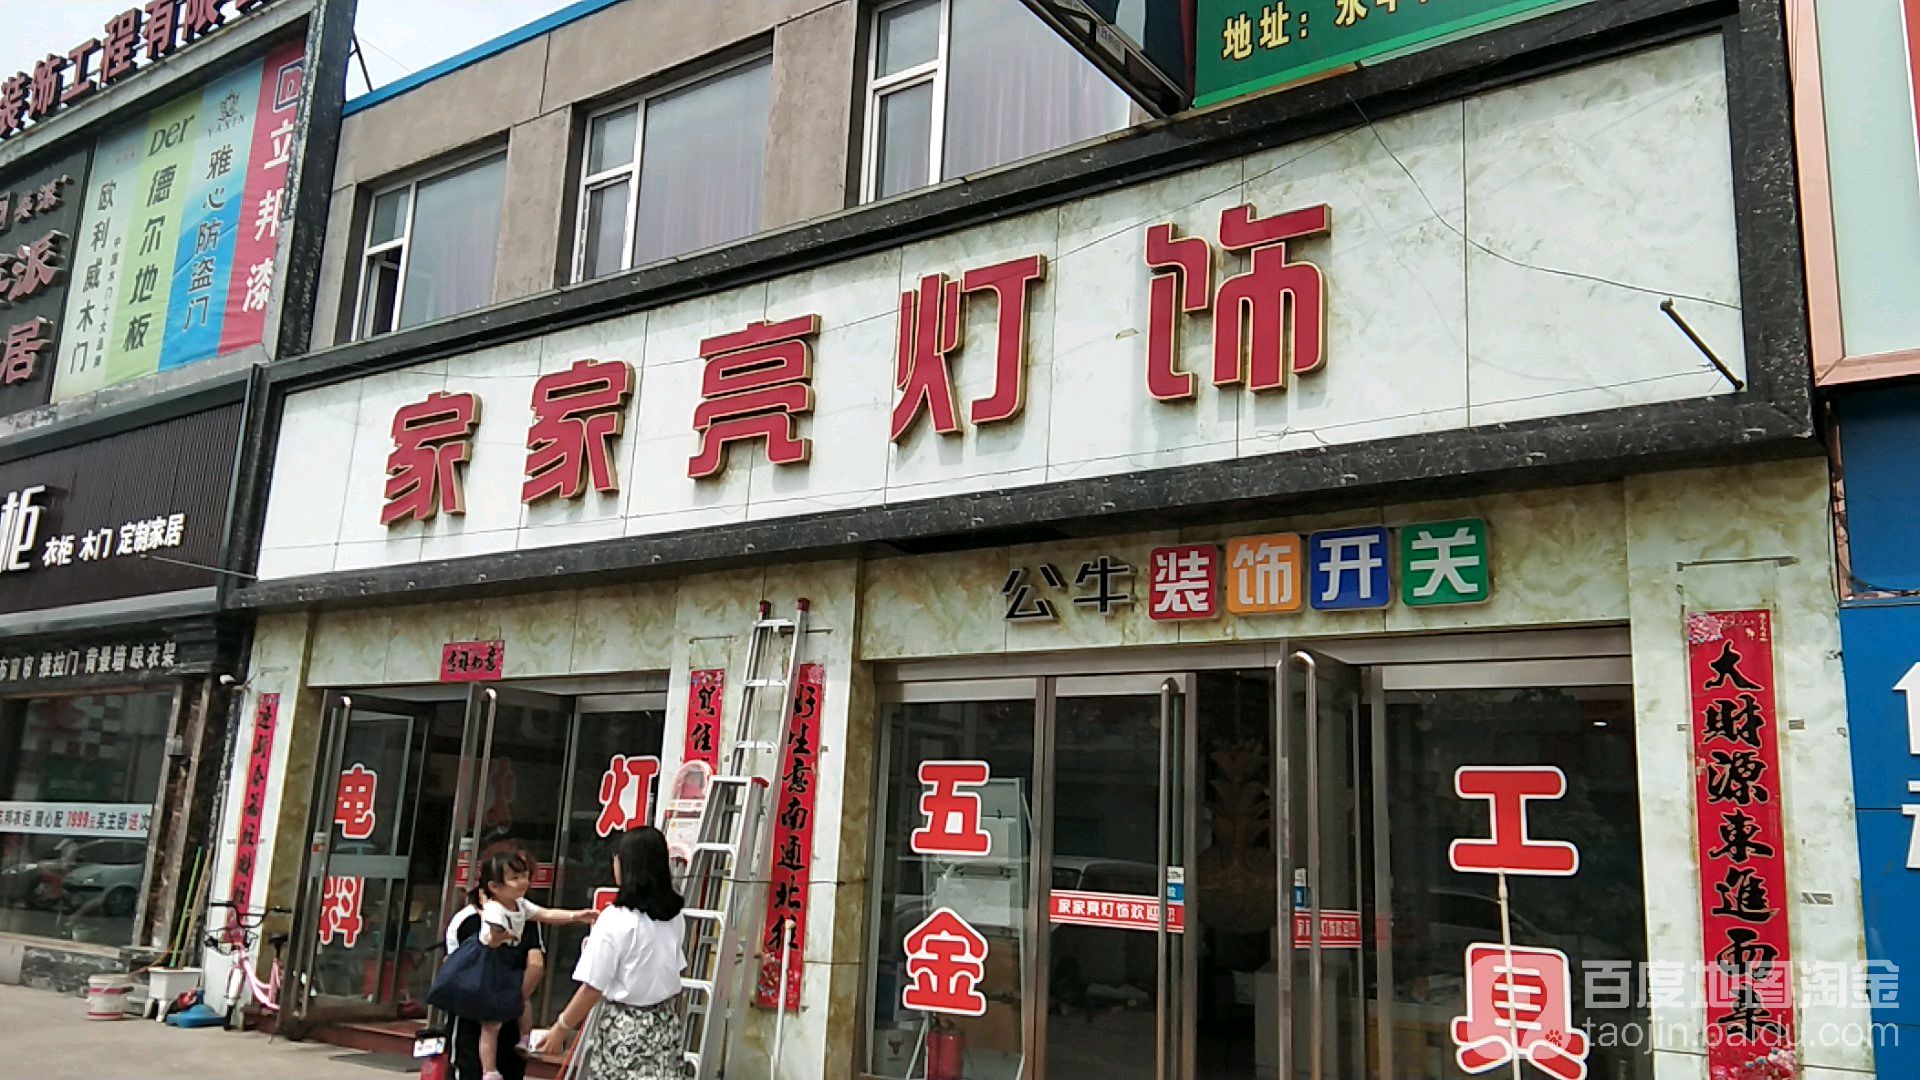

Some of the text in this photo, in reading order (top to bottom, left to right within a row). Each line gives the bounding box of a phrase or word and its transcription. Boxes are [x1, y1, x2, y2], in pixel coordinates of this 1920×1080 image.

[0, 0, 266, 136] 装饰工程有限
[148, 114, 195, 157] Der
[122, 163, 178, 353] 德尔地板
[183, 143, 234, 332] 雅心防盗门
[242, 118, 294, 314] 立邦漆
[0, 314, 48, 385] 居
[380, 203, 1331, 525] 家家亮灯饰
[42, 512, 187, 567] 衣柜 木门 定制家居
[39, 649, 80, 678] 推拉门
[902, 759, 991, 1017] 五金
[1449, 765, 1590, 1080] 工具
